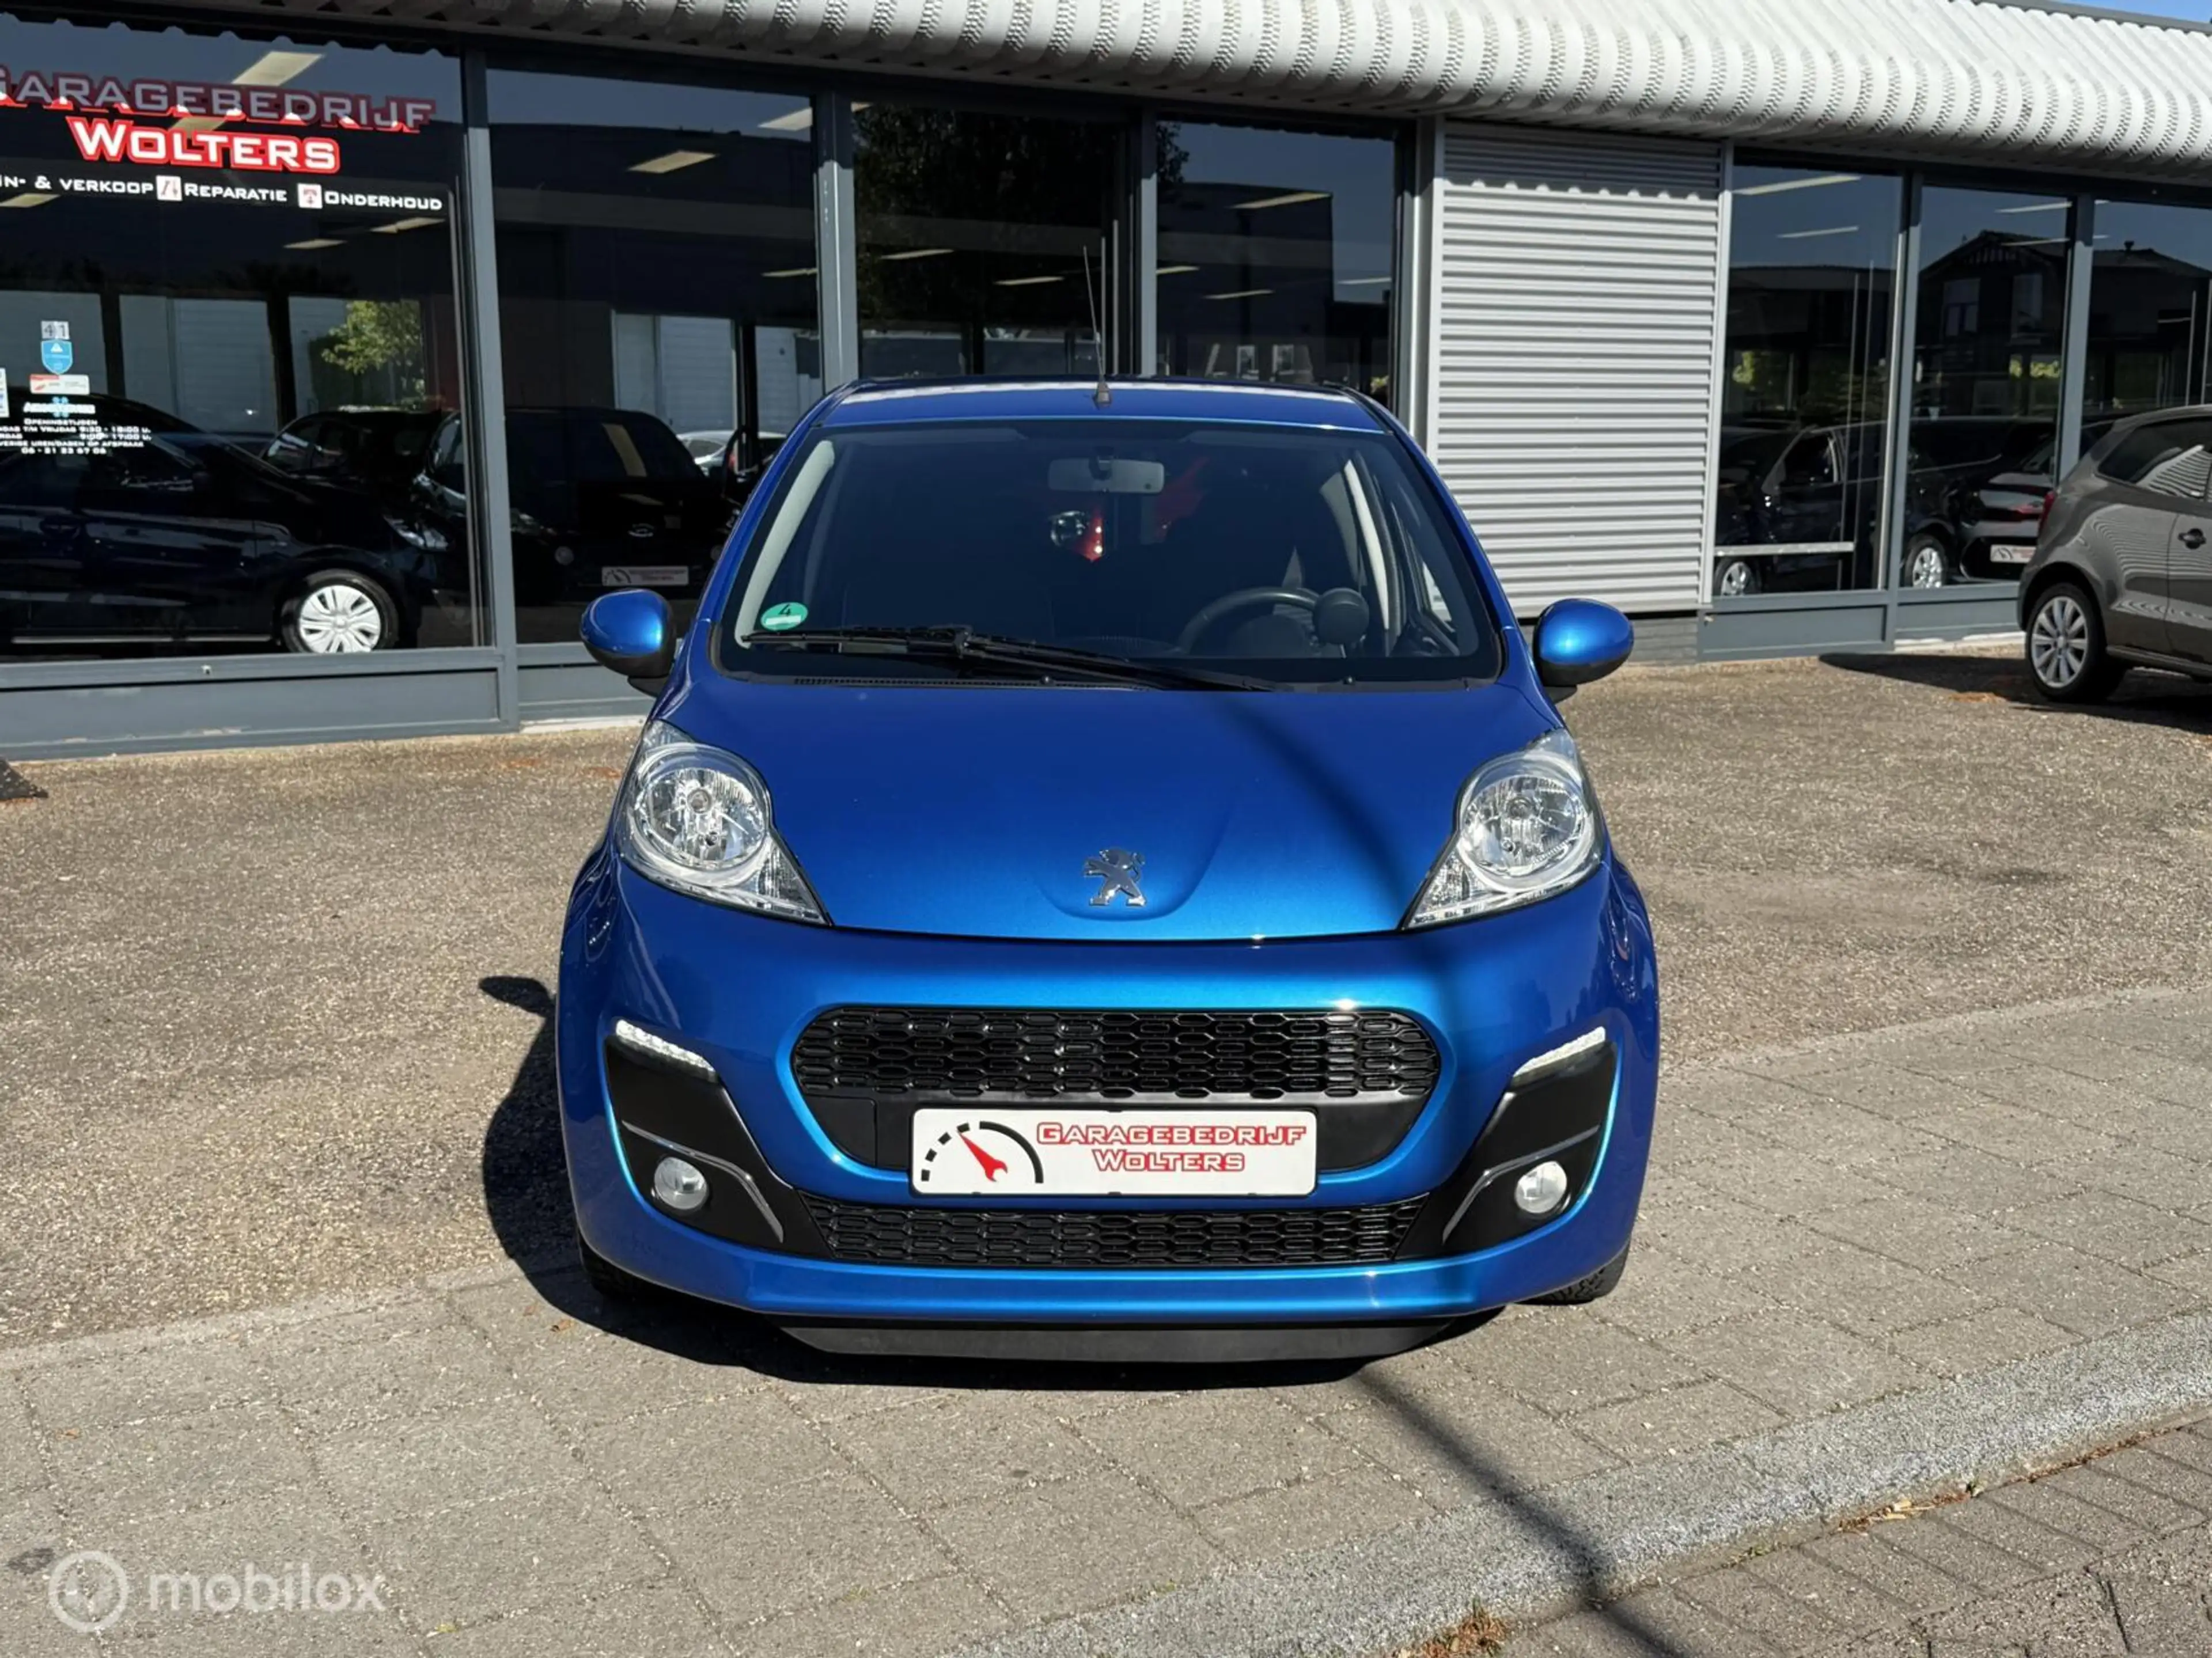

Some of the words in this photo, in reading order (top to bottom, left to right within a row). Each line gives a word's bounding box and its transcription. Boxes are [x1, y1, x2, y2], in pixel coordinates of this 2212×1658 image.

[65, 116, 340, 173] WOLTERS
[35, 176, 52, 190] &
[59, 177, 154, 195] VERKOOP
[184, 183, 287, 202] REPARATIE
[324, 191, 442, 210] ONDERHOUD
[44, 324, 66, 337] 41
[778, 604, 791, 616] 4
[1037, 1122, 1306, 1145] GARAGEBEDRIJF
[1092, 1149, 1245, 1172] WOLTERS
